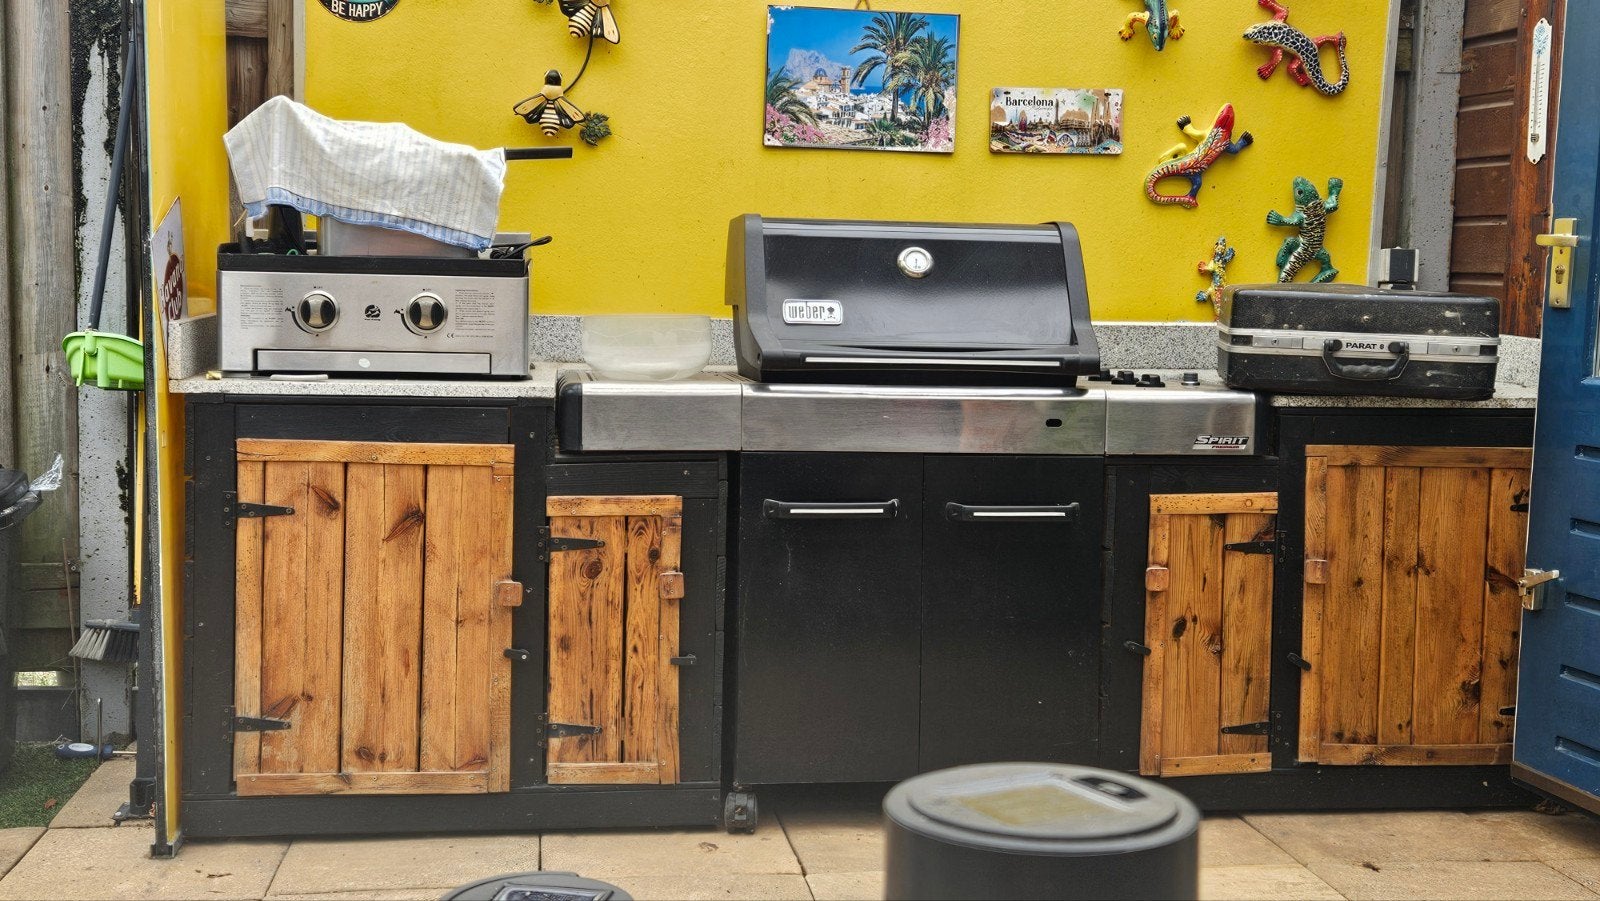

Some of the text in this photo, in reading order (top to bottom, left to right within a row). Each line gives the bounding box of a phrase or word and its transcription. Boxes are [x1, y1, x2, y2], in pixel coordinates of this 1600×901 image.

[331, 0, 383, 17] BE HAPPY
[1005, 96, 1054, 107] Barcelona
[788, 301, 825, 319] weber
[1345, 342, 1377, 350] PARAT
